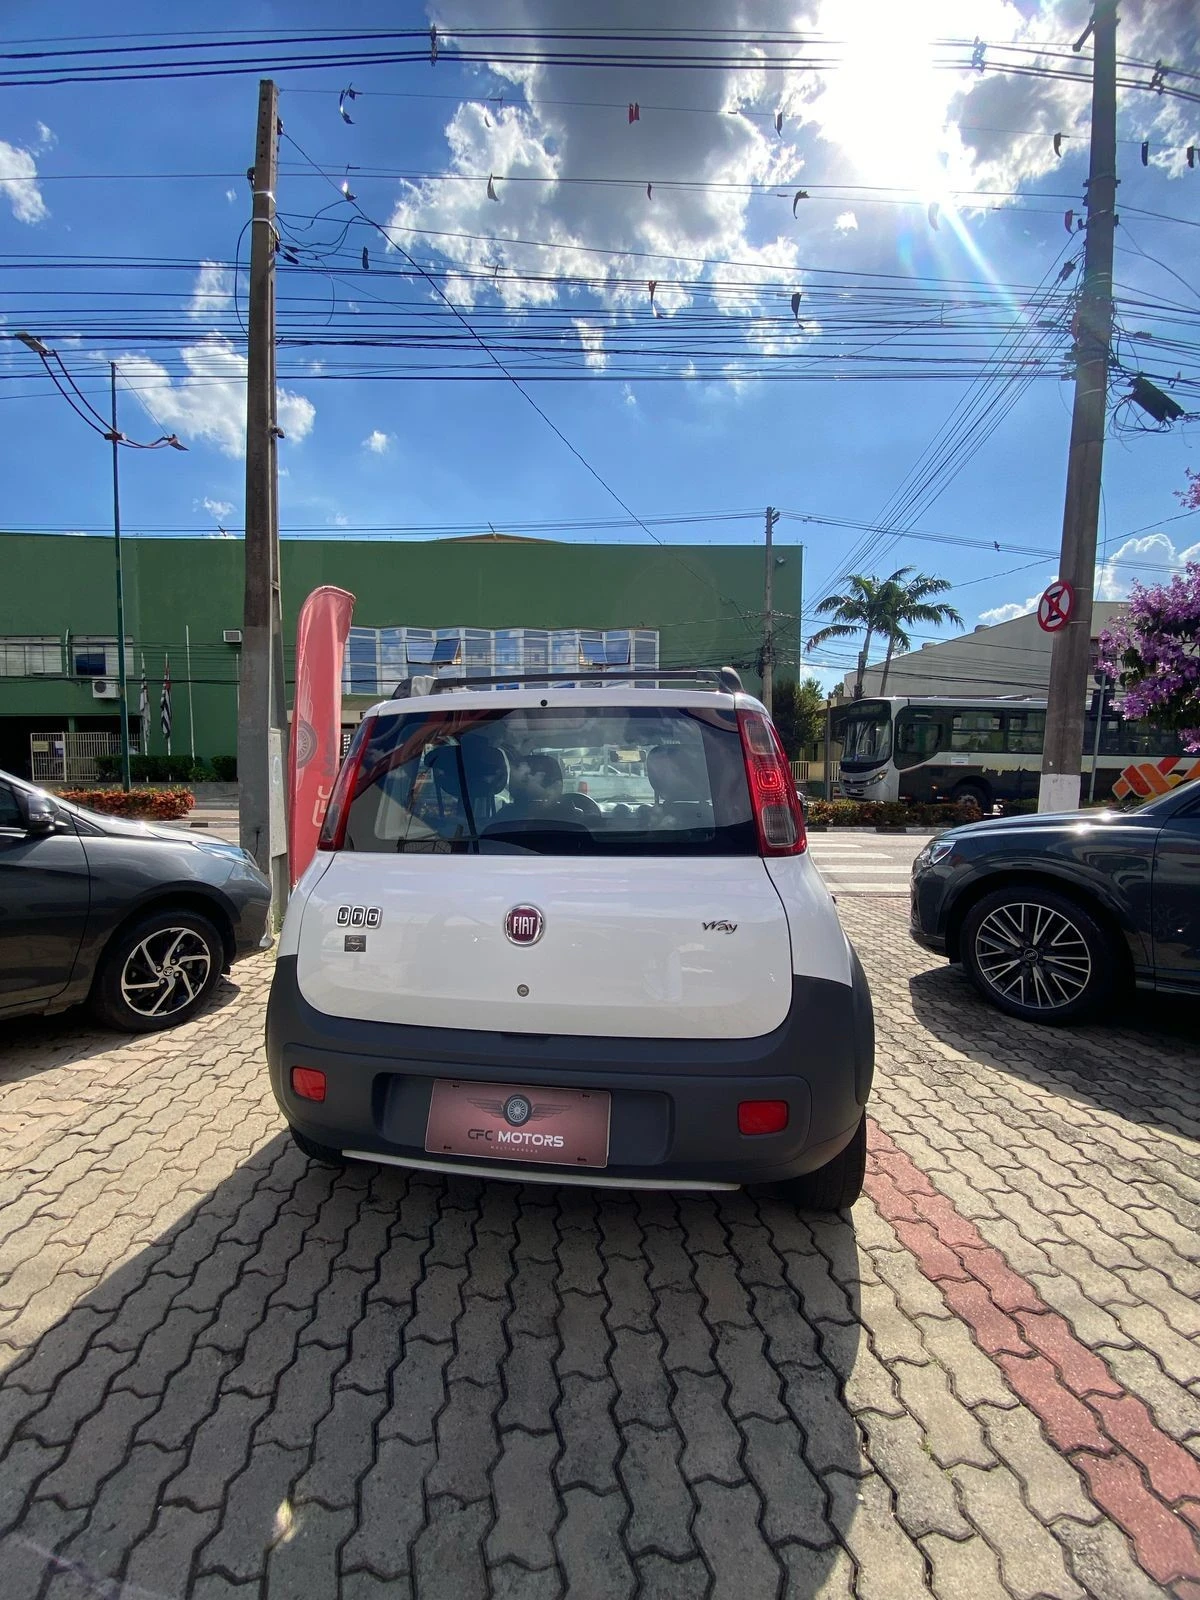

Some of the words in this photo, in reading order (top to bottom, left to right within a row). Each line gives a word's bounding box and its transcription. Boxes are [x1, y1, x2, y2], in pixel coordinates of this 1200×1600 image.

[513, 916, 535, 935] FIAT
[702, 920, 738, 934] Way
[467, 1128, 493, 1142] CFC
[498, 1130, 564, 1147] MOTORS
